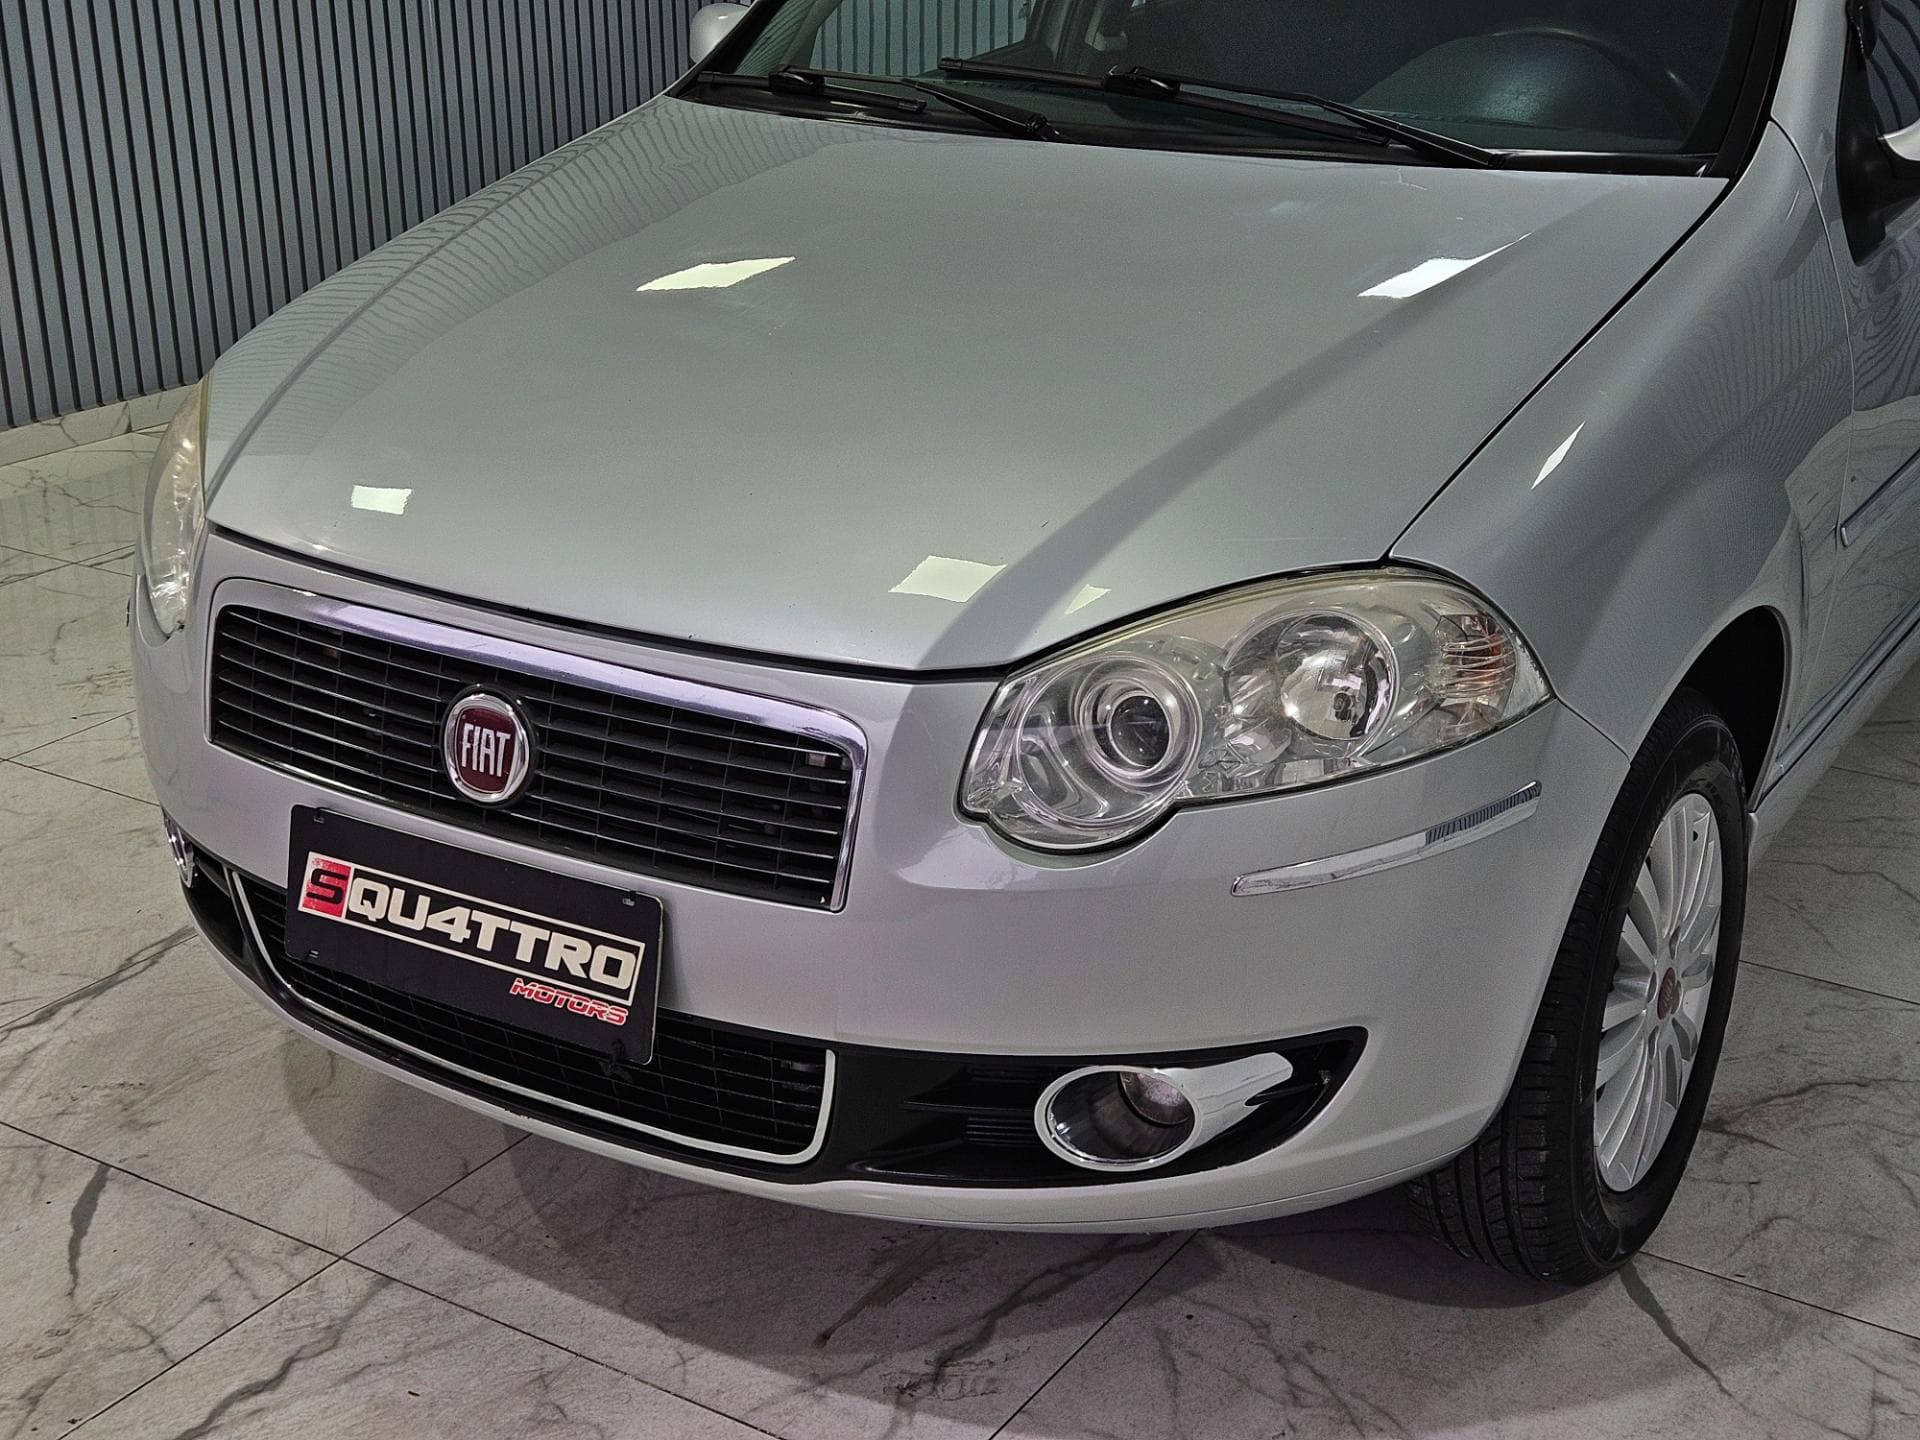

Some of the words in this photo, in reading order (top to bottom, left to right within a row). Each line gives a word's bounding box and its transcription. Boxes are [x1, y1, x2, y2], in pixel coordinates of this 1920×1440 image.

[461, 722, 511, 777] FIAT
[305, 868, 637, 990] SQU4TTRO
[510, 978, 628, 1026] MOTORS
